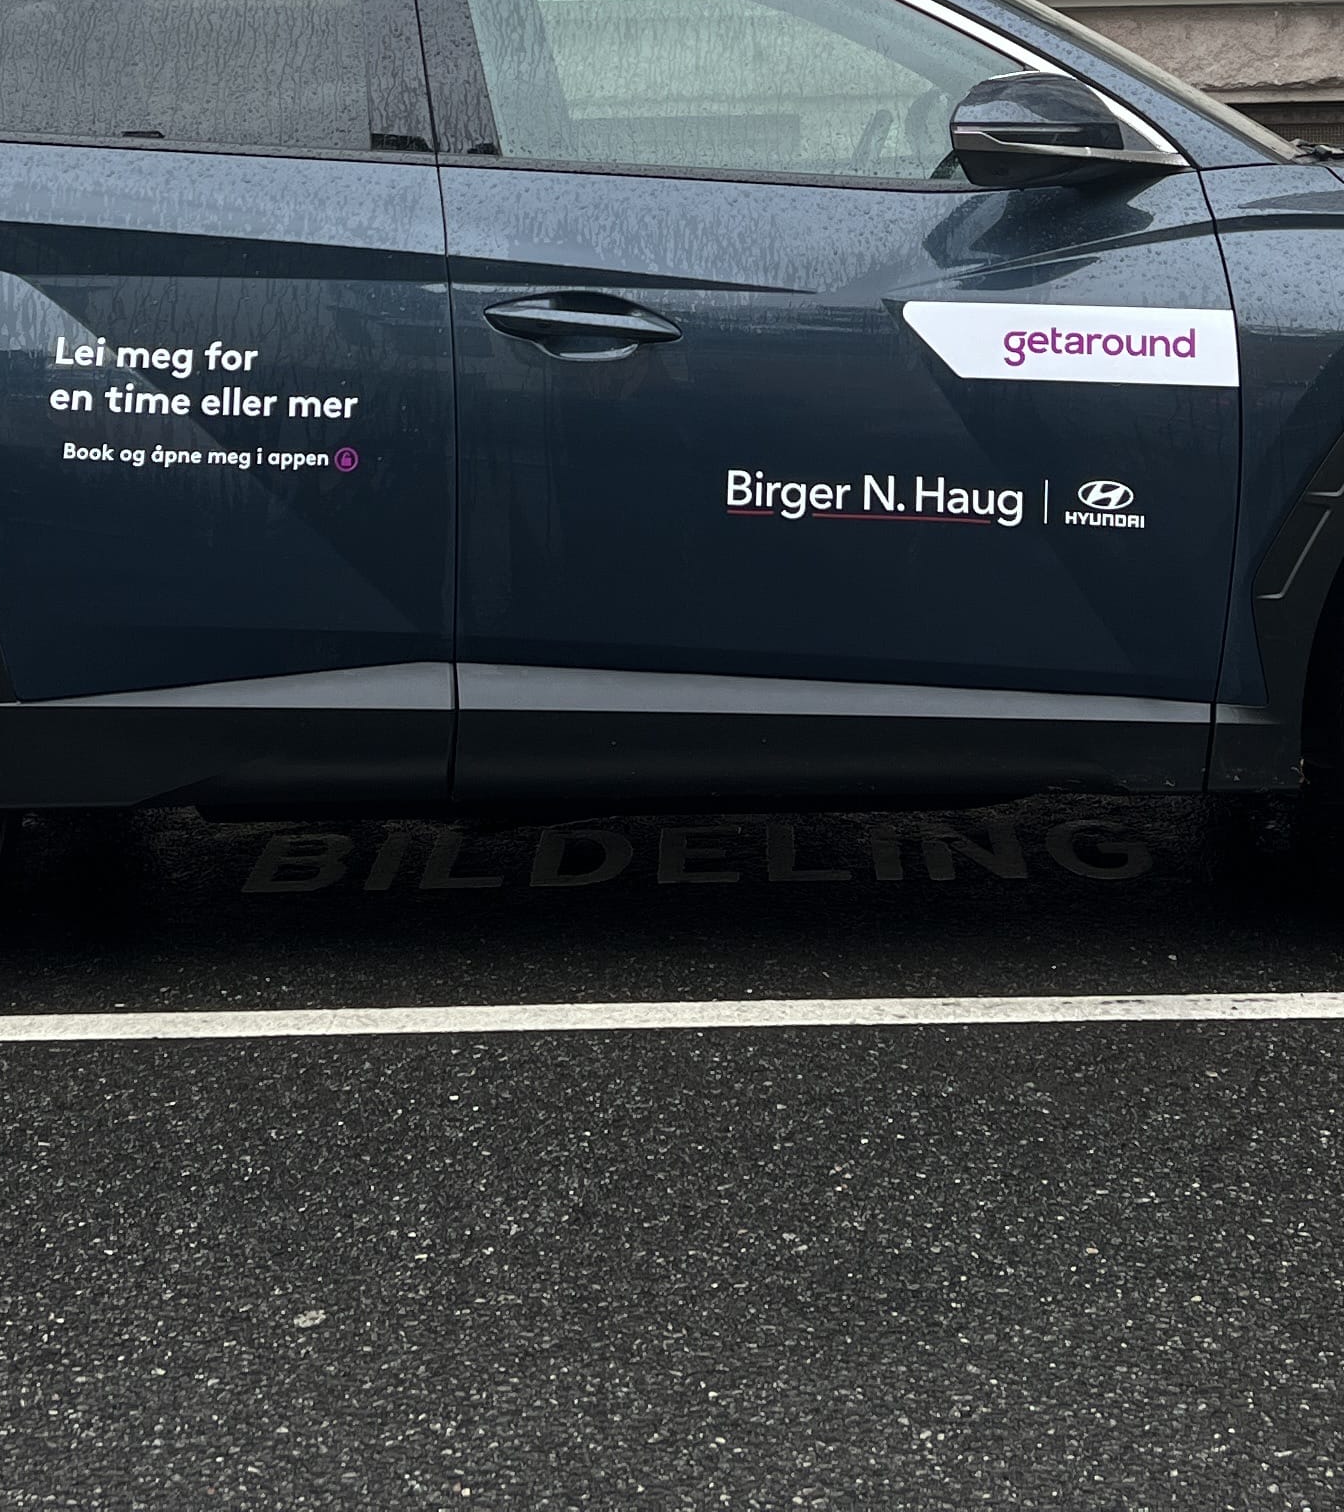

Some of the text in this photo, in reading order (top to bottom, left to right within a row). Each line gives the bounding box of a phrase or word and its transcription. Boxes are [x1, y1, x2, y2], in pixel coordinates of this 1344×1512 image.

[55, 336, 259, 378] Lei meg for
[1003, 327, 1196, 366] getaround
[49, 383, 358, 418] en time eller mer
[62, 443, 329, 471] Book og åpne meg i appen
[726, 469, 1024, 528] Birger N. Haug
[1064, 509, 1146, 530] HYUNDAI
[241, 818, 1154, 893] BILDELING
